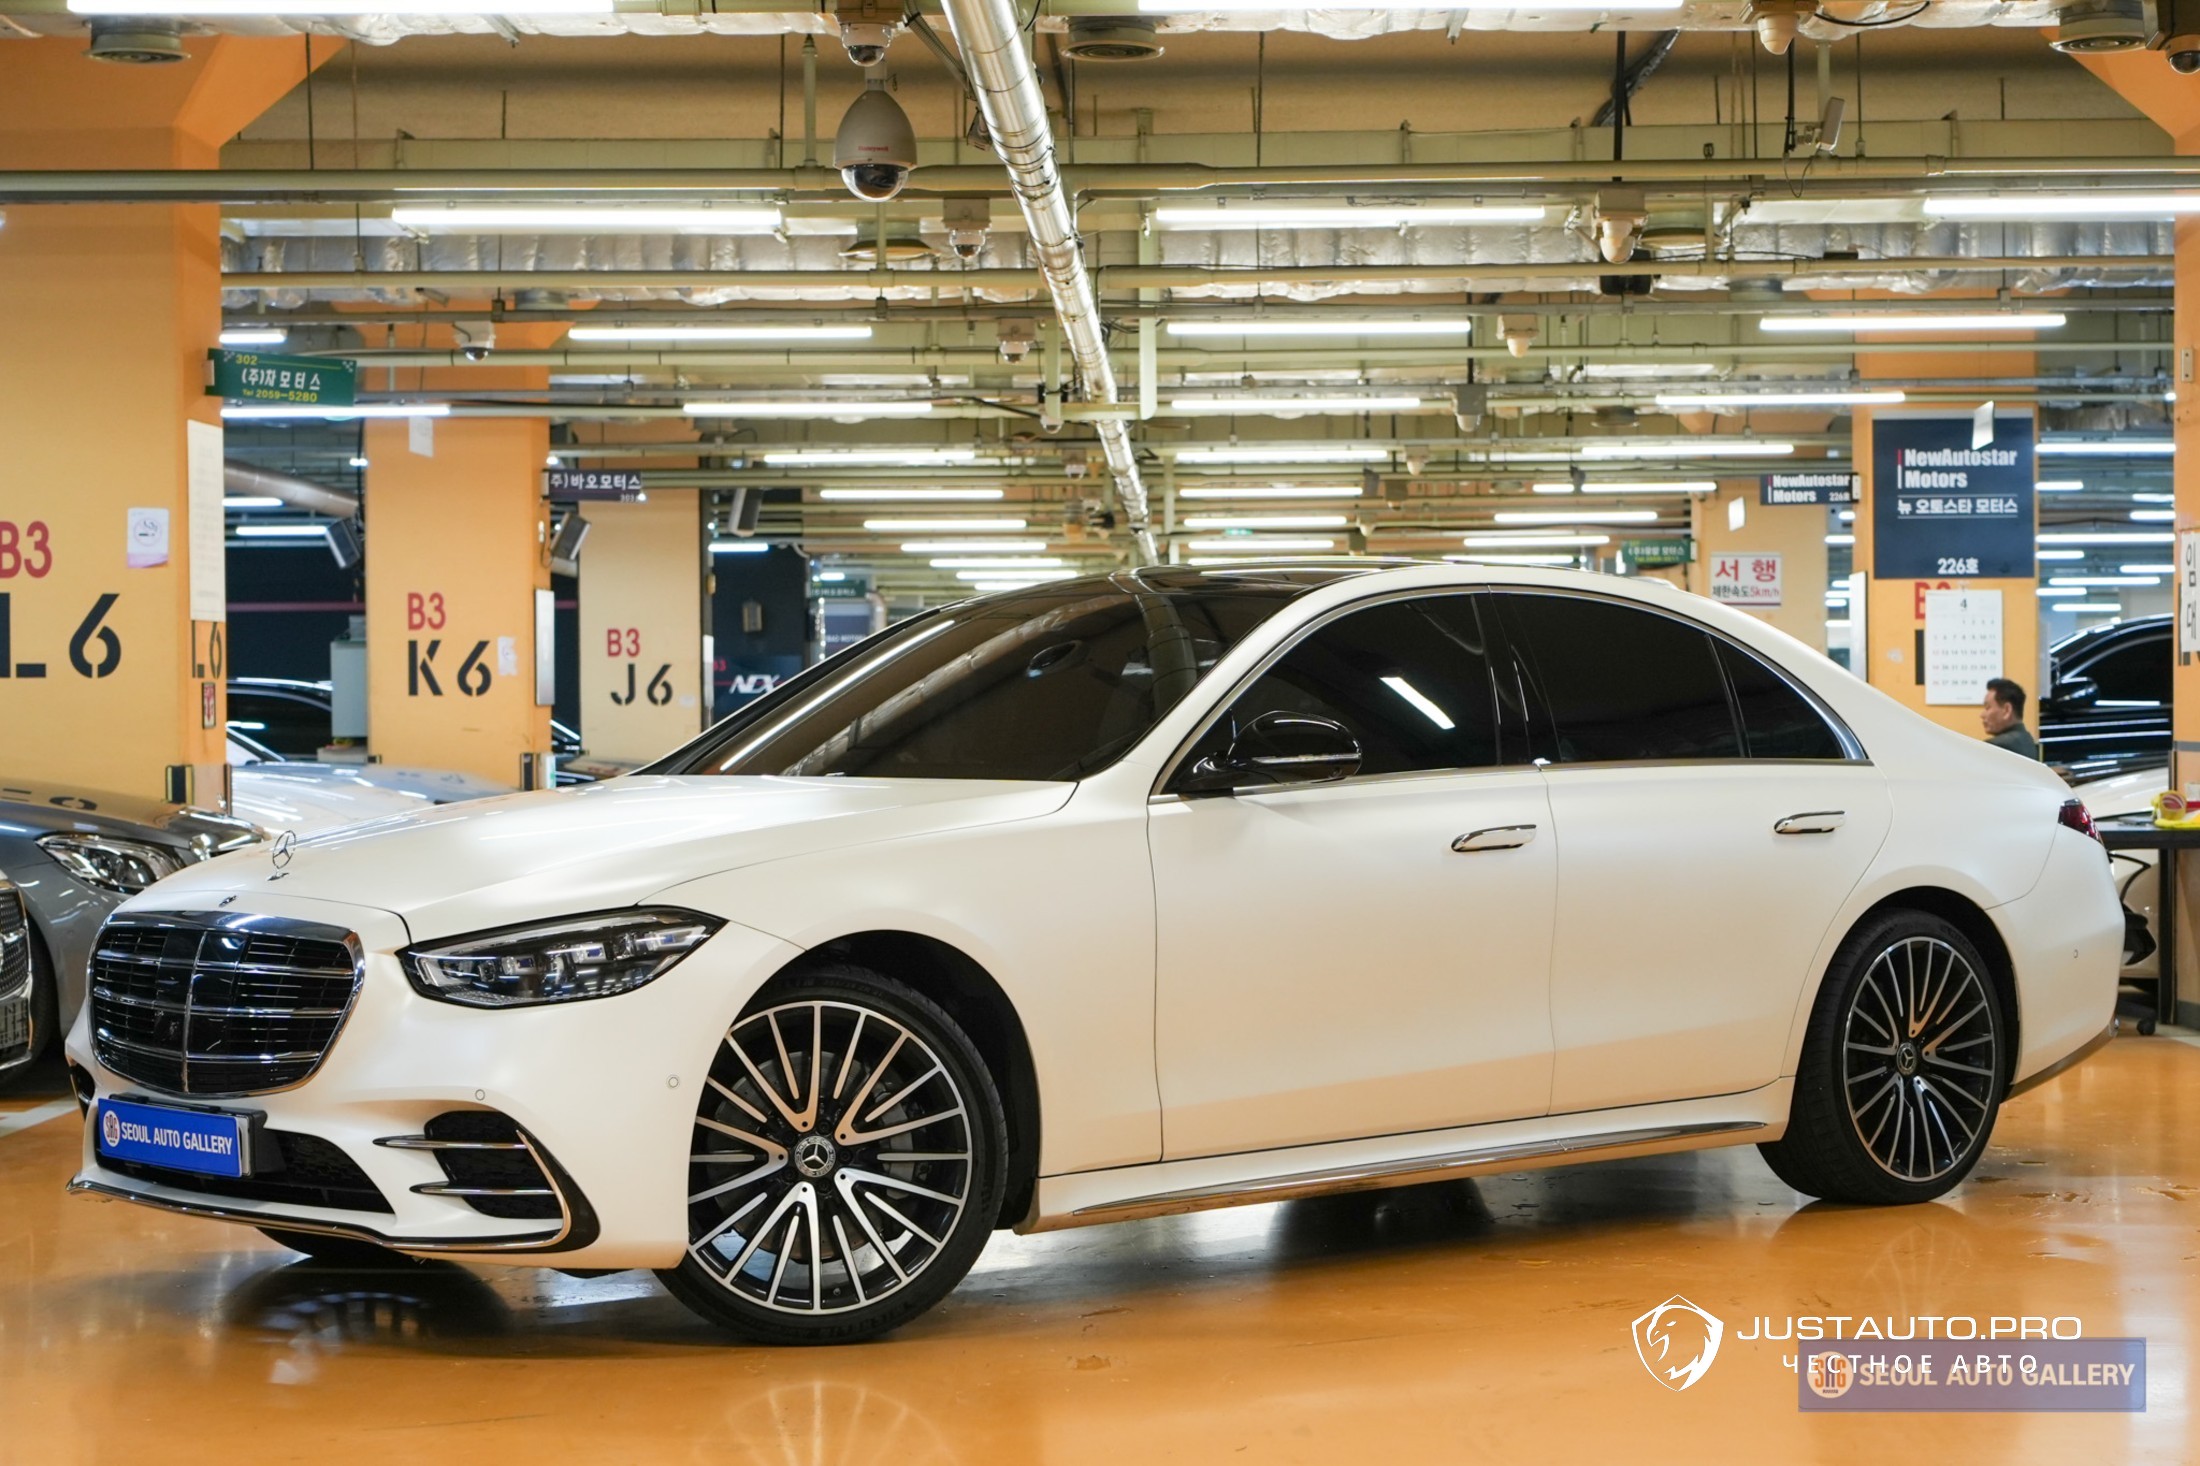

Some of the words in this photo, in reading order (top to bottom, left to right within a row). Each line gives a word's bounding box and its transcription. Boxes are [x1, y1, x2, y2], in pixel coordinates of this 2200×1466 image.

[235, 354, 258, 365] 302
[256, 389, 318, 403] 2059-5280
[1904, 448, 2017, 467] NewAutostar
[1904, 470, 1968, 488] Motors
[1773, 489, 1817, 503] Motors
[1897, 499, 1913, 515] 뉴
[1915, 498, 1973, 514] 오토스타
[1976, 498, 2018, 513] 모터스
[0, 520, 52, 579] B3
[1937, 557, 1980, 575] 226호
[408, 592, 446, 631] B3
[607, 628, 641, 657] B3
[121, 1121, 151, 1144] SEOUL
[153, 1127, 180, 1149] AUTO
[183, 1131, 232, 1155] GALLERY
